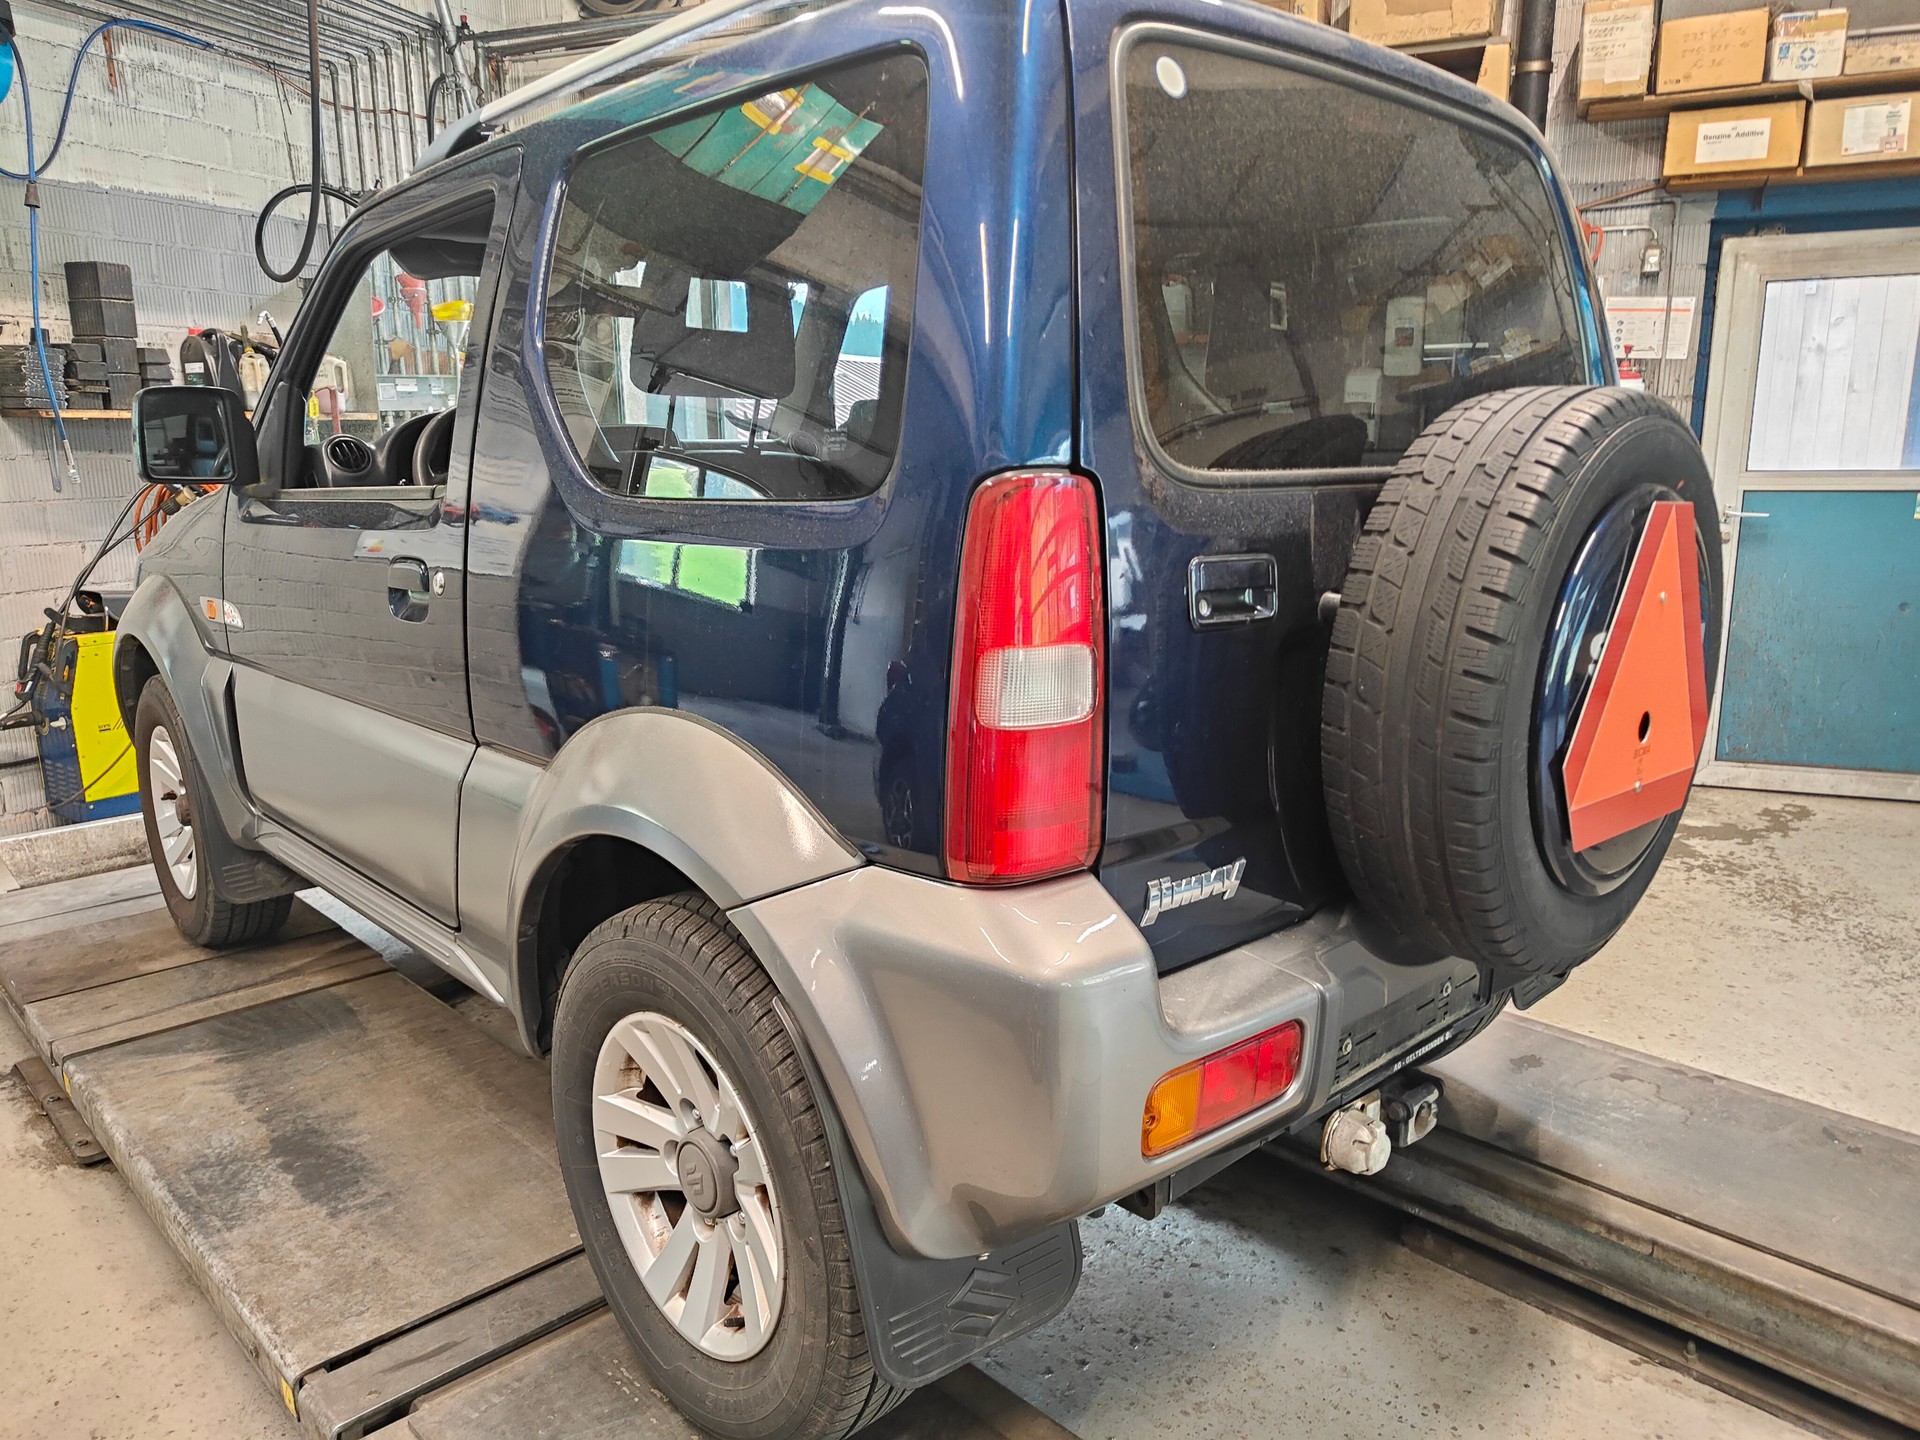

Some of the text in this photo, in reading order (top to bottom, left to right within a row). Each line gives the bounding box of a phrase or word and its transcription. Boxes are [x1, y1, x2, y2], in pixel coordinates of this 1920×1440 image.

[1794, 62, 1818, 71] agru
[1703, 130, 1764, 141] Benzine Additive
[1393, 1061, 1402, 1072] AG
[1405, 1035, 1445, 1064] GELTERKINDEN
